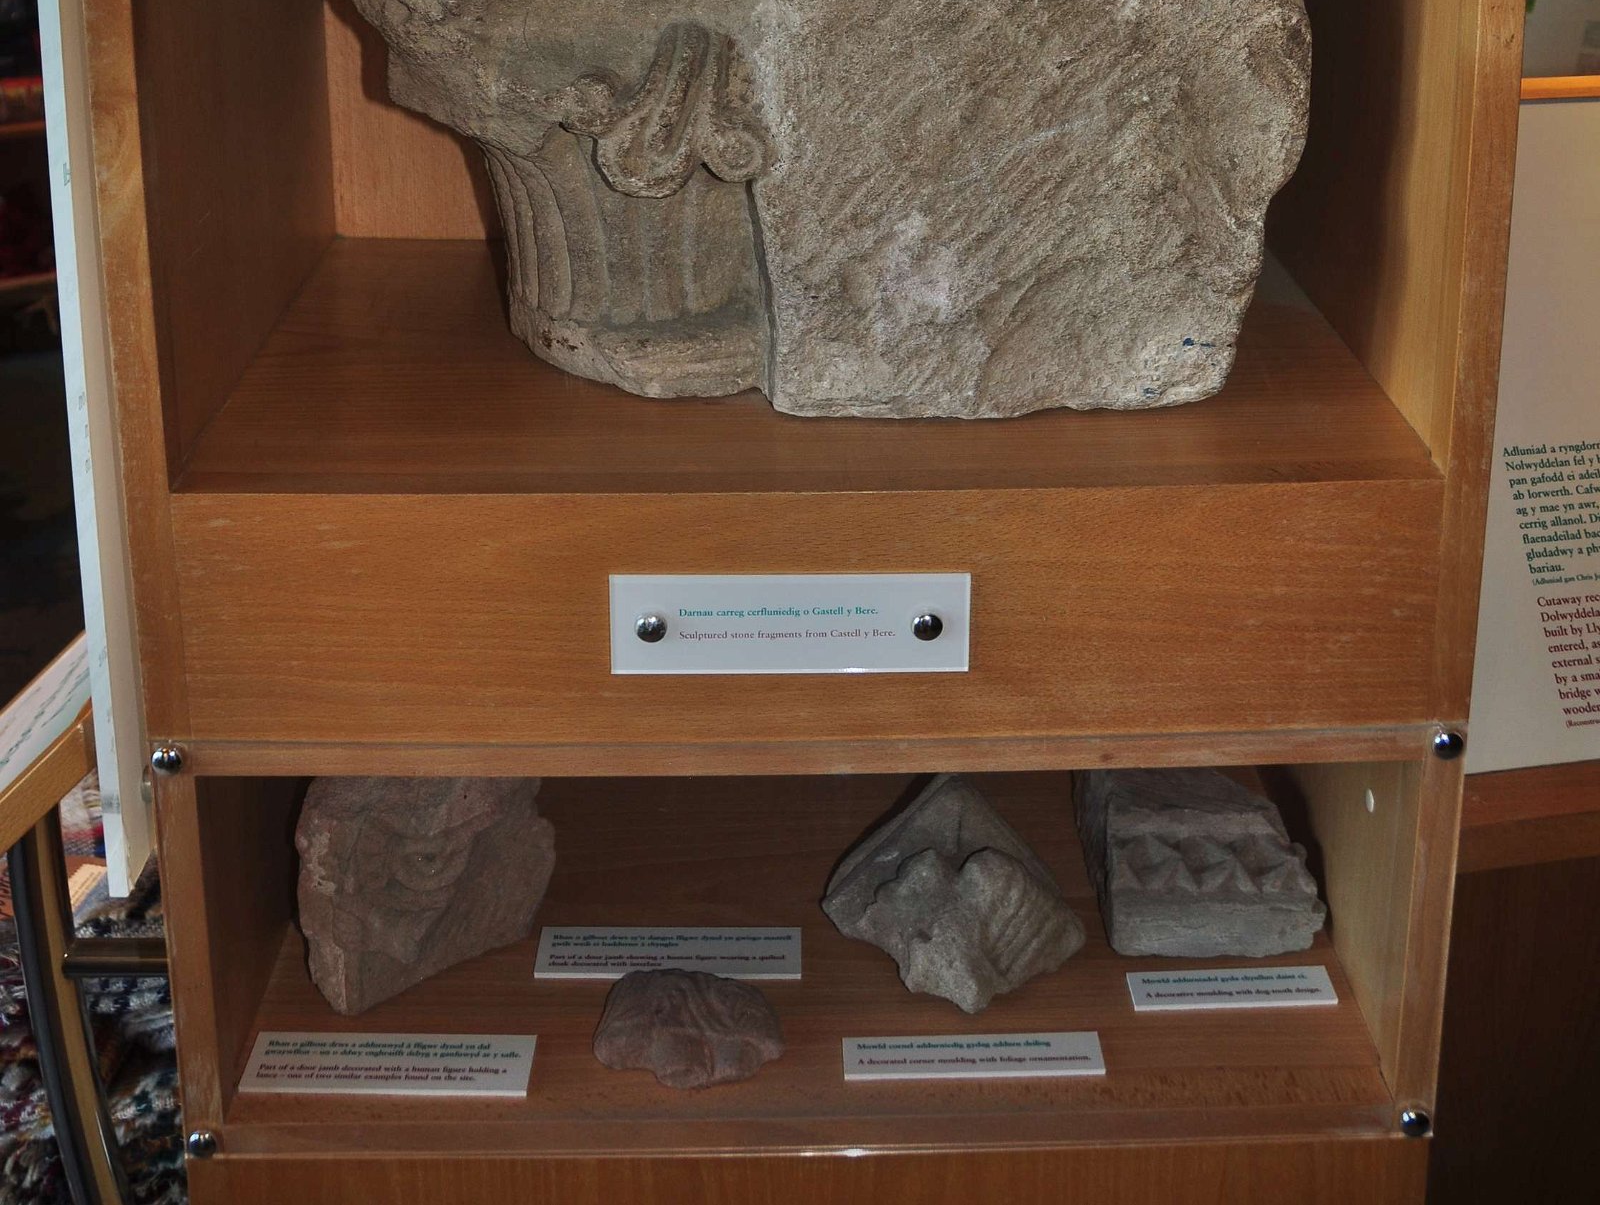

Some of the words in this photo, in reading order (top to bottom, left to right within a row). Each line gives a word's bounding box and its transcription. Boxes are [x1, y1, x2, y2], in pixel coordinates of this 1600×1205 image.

[1503, 444, 1547, 457] Adluniad
[1505, 458, 1570, 472] Nolwyddelan
[1573, 456, 1585, 466] fel
[1509, 477, 1527, 488] pan
[1530, 471, 1564, 486] gafodd
[1567, 471, 1576, 481] ei
[1513, 490, 1524, 500] ab
[1516, 507, 1528, 516] ag
[1540, 504, 1560, 513] mae
[1563, 502, 1575, 513] yn
[1519, 518, 1548, 530] cerrig
[1551, 516, 1586, 526] allanol.
[1522, 530, 1581, 544] flaenadeilad
[1526, 547, 1573, 562] gludadwy
[1529, 562, 1565, 574] bariau.
[1537, 594, 1582, 607] Cutaway
[679, 607, 713, 617] Darnau
[716, 609, 746, 619] carreg
[747, 606, 801, 619] cerfluniedig
[812, 606, 843, 615] Gastell
[855, 605, 878, 614] Bere.
[679, 630, 727, 642] Sculptured
[730, 630, 755, 639] stone
[757, 628, 802, 641] fragments
[805, 628, 828, 638] from
[830, 628, 861, 637] Castell
[872, 627, 896, 637] Bere.
[1544, 626, 1568, 638] built
[1570, 624, 1583, 636] by
[1548, 639, 1589, 653] entered,
[1552, 654, 1592, 668] external
[1554, 673, 1568, 686] by
[1558, 687, 1591, 701] bridge
